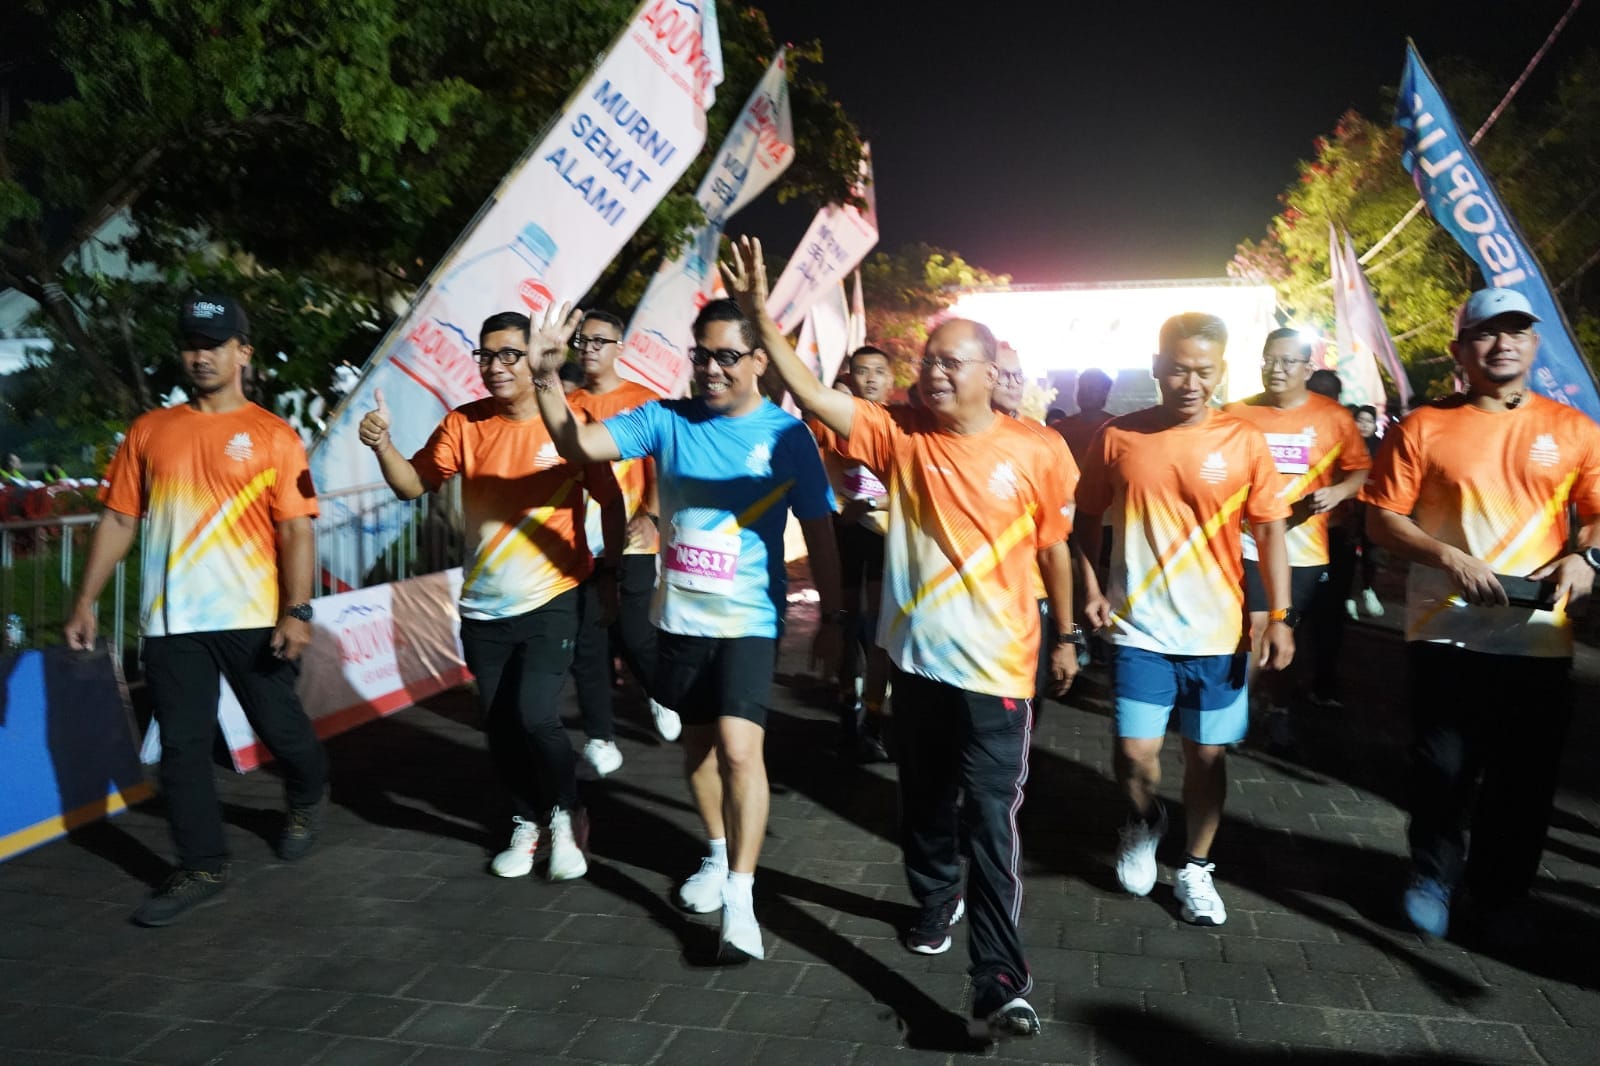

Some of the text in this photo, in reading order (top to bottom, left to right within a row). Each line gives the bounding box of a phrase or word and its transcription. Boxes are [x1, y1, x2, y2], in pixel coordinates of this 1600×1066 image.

[571, 113, 652, 193] SEHAT
[593, 80, 679, 167] MURNI
[545, 146, 627, 227] ALAMI
[676, 546, 736, 574] N5617
